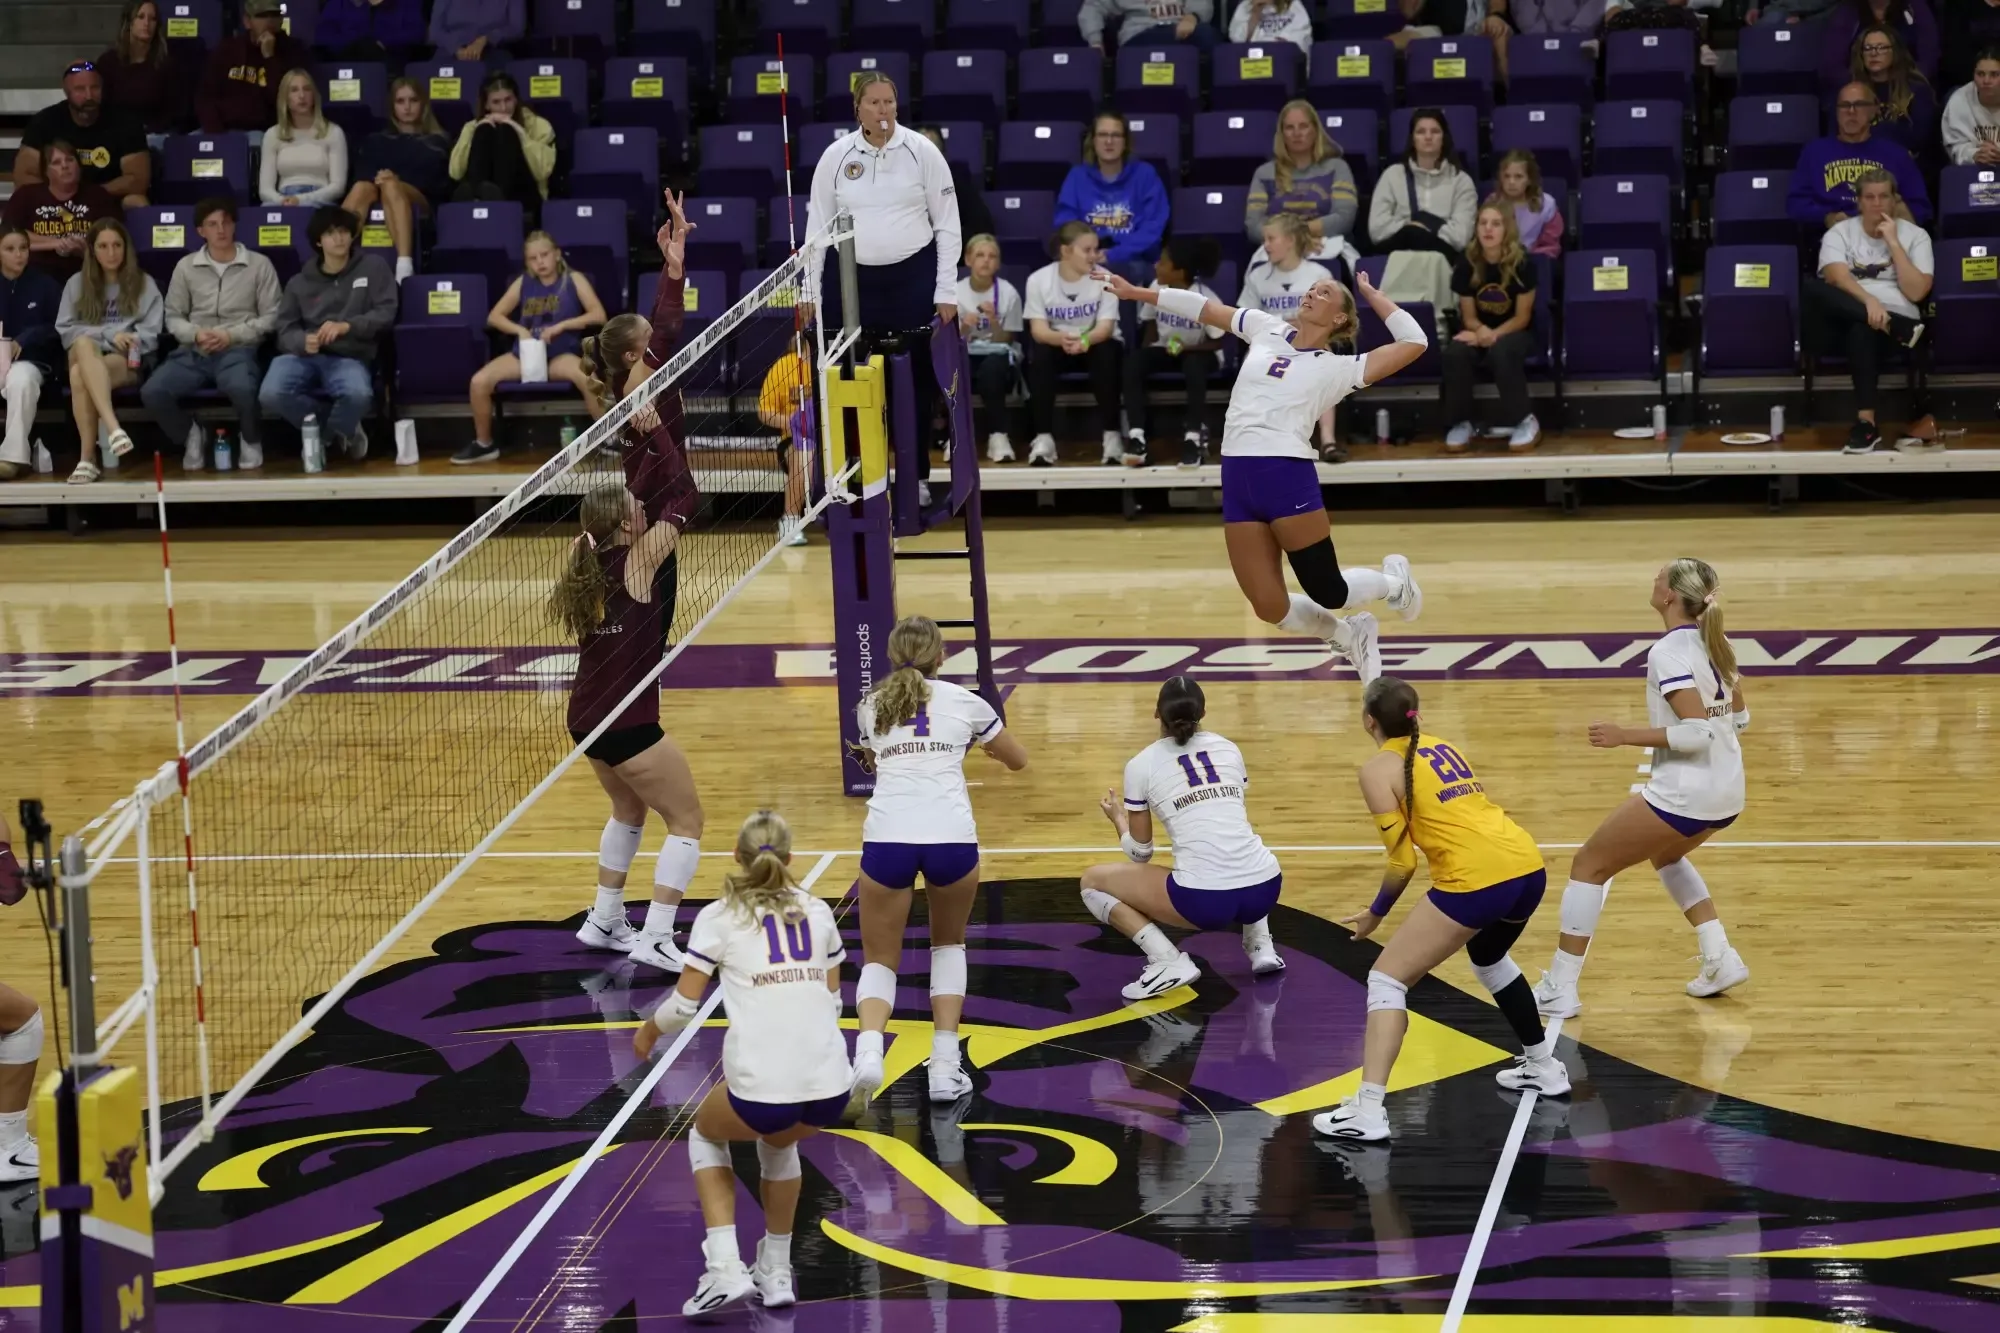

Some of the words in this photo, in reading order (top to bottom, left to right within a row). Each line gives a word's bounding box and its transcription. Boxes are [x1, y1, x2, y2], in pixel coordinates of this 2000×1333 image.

[1266, 356, 1292, 379] 2
[856, 623, 873, 669] sports
[899, 696, 931, 738] 4
[881, 742, 926, 760] MINNESOTA
[930, 741, 954, 753] STATE
[1176, 750, 1221, 788] 11
[1416, 743, 1474, 785] 20
[1172, 787, 1219, 811] MINNESOTA
[1220, 786, 1240, 798] STATE
[761, 912, 812, 964] 10
[752, 968, 805, 987] MINNESOTA
[117, 1275, 145, 1331] M
